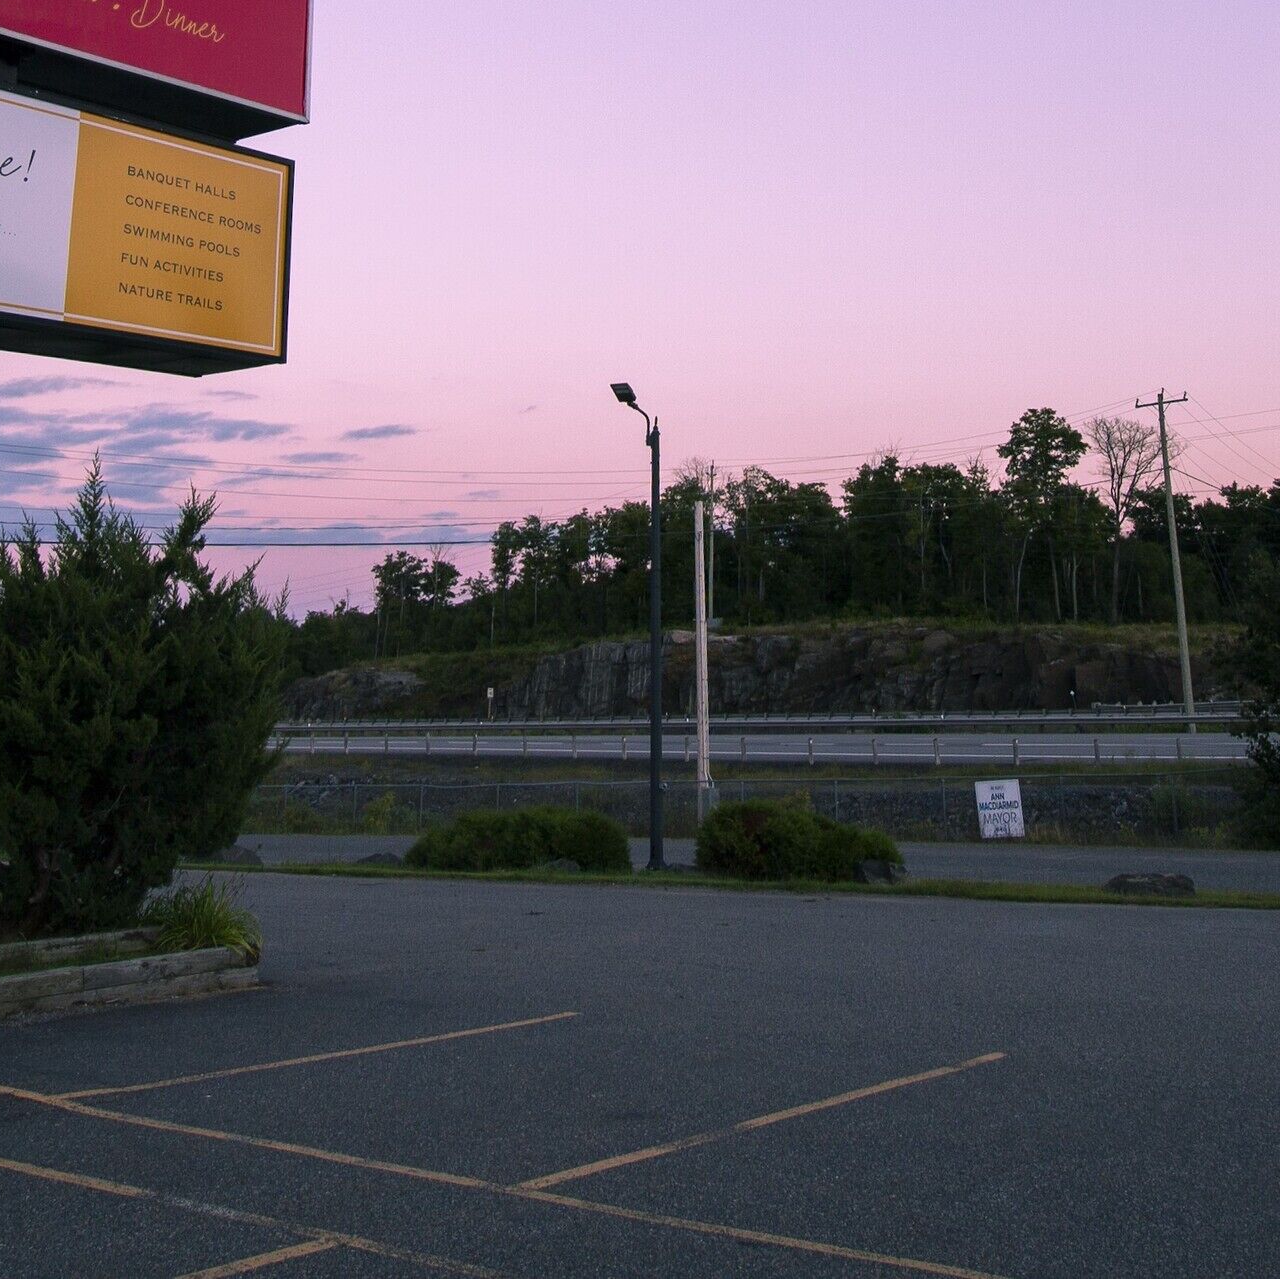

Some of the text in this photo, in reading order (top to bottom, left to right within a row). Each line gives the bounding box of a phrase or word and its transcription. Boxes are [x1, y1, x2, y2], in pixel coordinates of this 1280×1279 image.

[127, 165, 237, 200] BANQUET HALLS
[125, 194, 262, 235] CONFERENCE ROOMS
[123, 223, 241, 257] SWIMMING POOLS
[121, 252, 224, 282] FUN ACTIVITIES
[118, 282, 223, 311] NATURE TRAILS
[983, 812, 1017, 824] MAYOR
